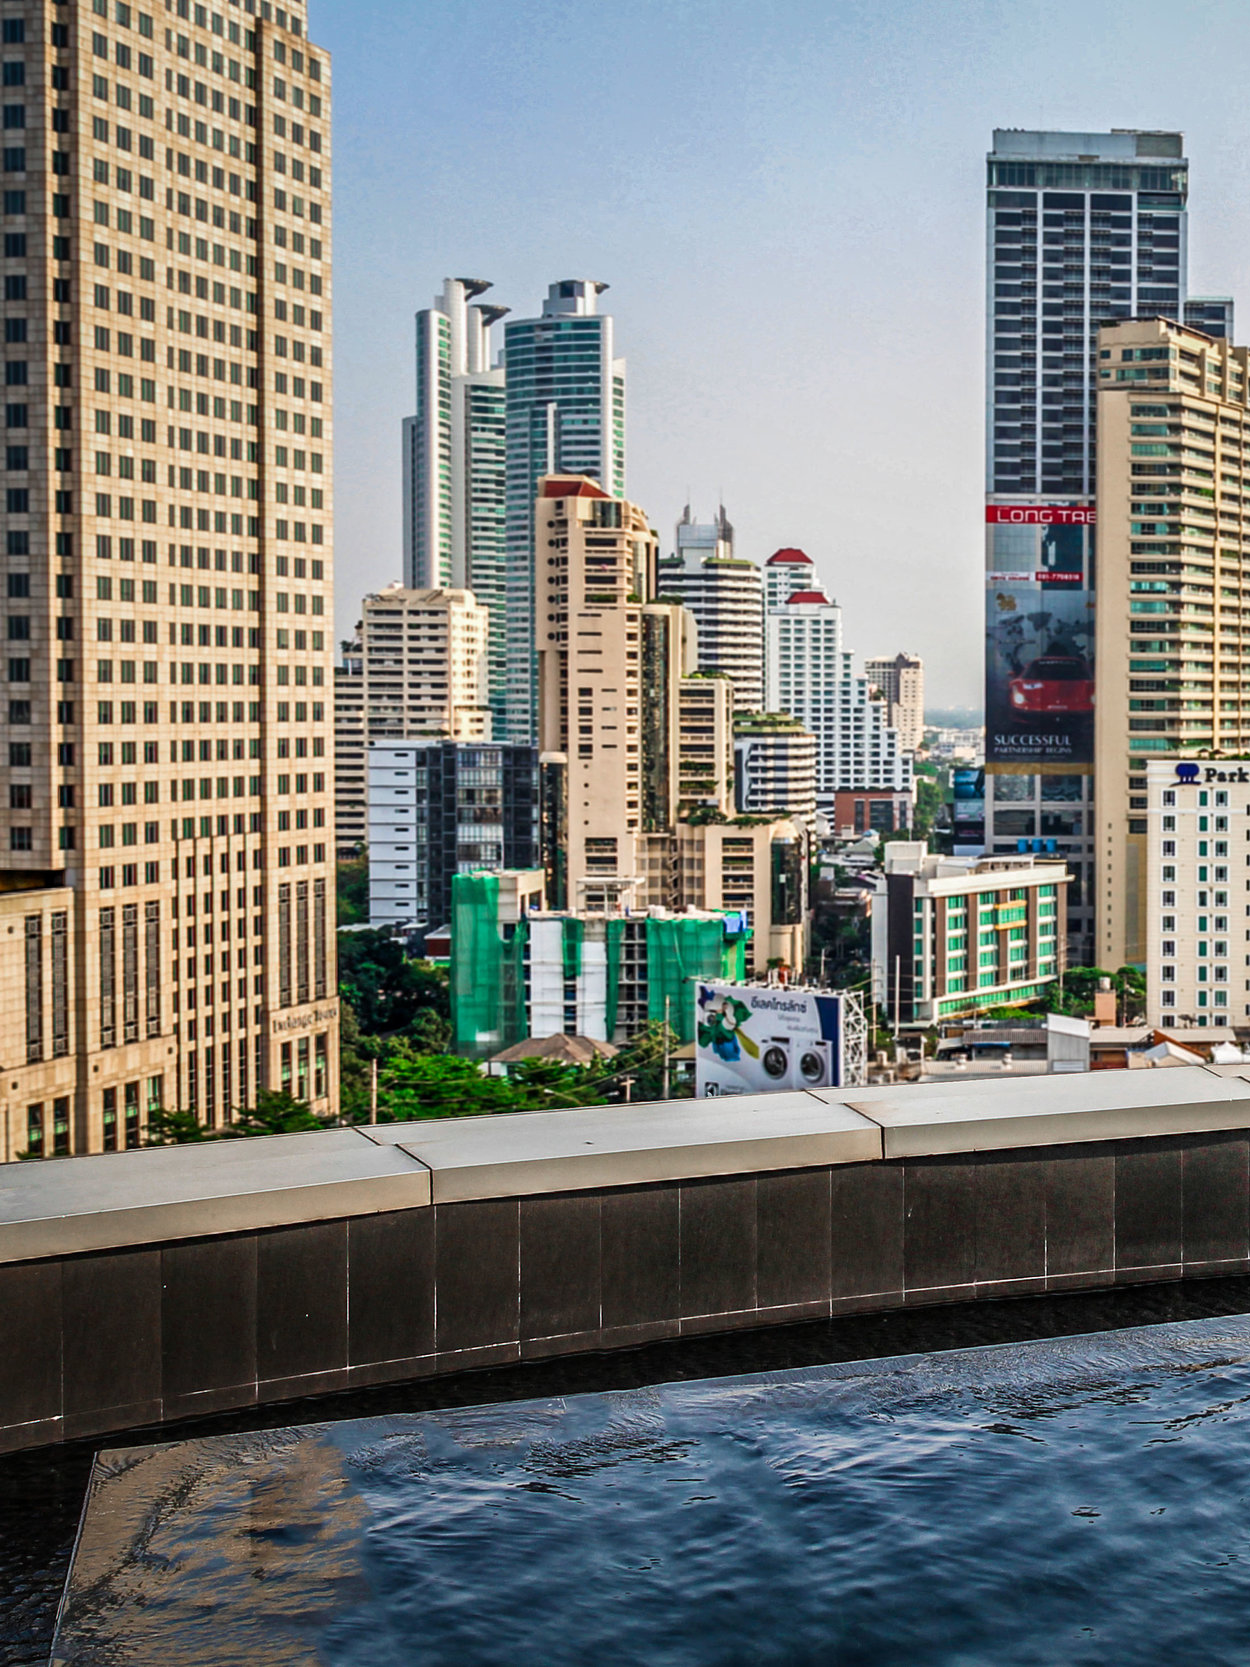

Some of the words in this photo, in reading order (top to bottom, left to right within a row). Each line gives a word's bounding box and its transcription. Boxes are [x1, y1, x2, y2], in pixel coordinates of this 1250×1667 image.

[997, 509, 1053, 523] LONG
[993, 734, 1072, 746] SUCCESSFUL
[1045, 746, 1072, 754] BEGINS
[1204, 766, 1249, 783] Park
